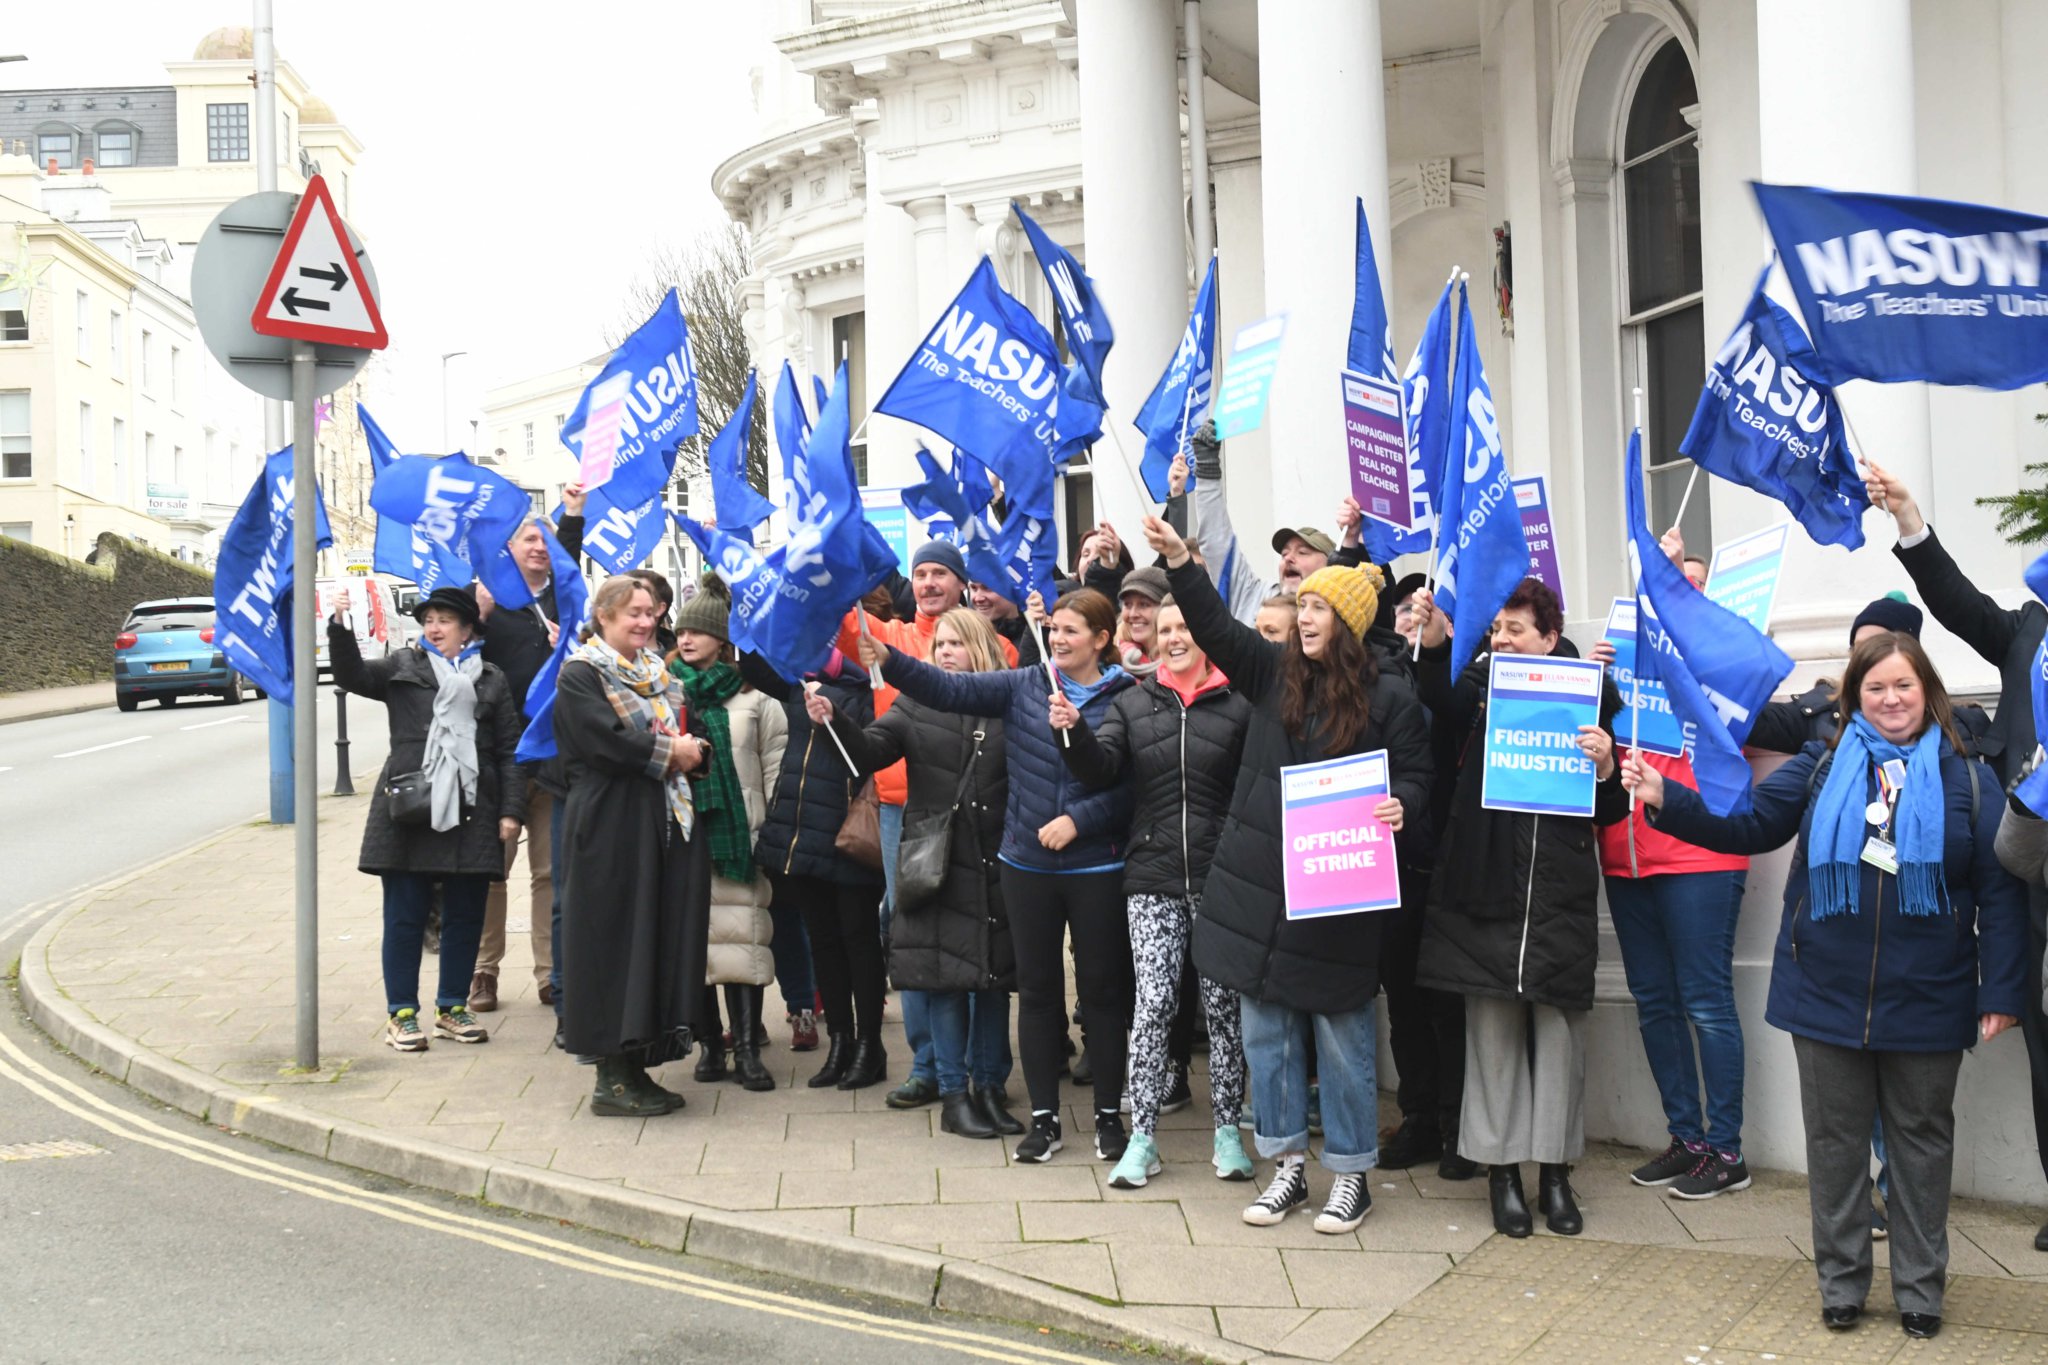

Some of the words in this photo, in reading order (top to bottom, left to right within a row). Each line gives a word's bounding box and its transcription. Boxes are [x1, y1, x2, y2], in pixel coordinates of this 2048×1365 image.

[1818, 299, 1867, 323] The
[917, 348, 949, 377] The
[929, 304, 1058, 410] NASU
[1714, 321, 1828, 440] NASU
[1347, 420, 1403, 448] CAMPAIGNING
[1735, 393, 1818, 459] Teachers'
[1350, 436, 1366, 451] FOR
[1367, 442, 1374, 453] A
[1374, 444, 1404, 464] BETTER
[1359, 455, 1380, 471] DEAL
[1380, 462, 1397, 477] FOR
[1359, 470, 1400, 494] TEACHERS
[149, 498, 163, 508] for
[166, 500, 188, 509] sale
[1526, 540, 1549, 553] TER
[1529, 557, 1540, 569] R
[1490, 751, 1592, 774] INJUSTICE
[1293, 825, 1384, 853] OFFICIAL
[1303, 850, 1377, 875] STRIKE
